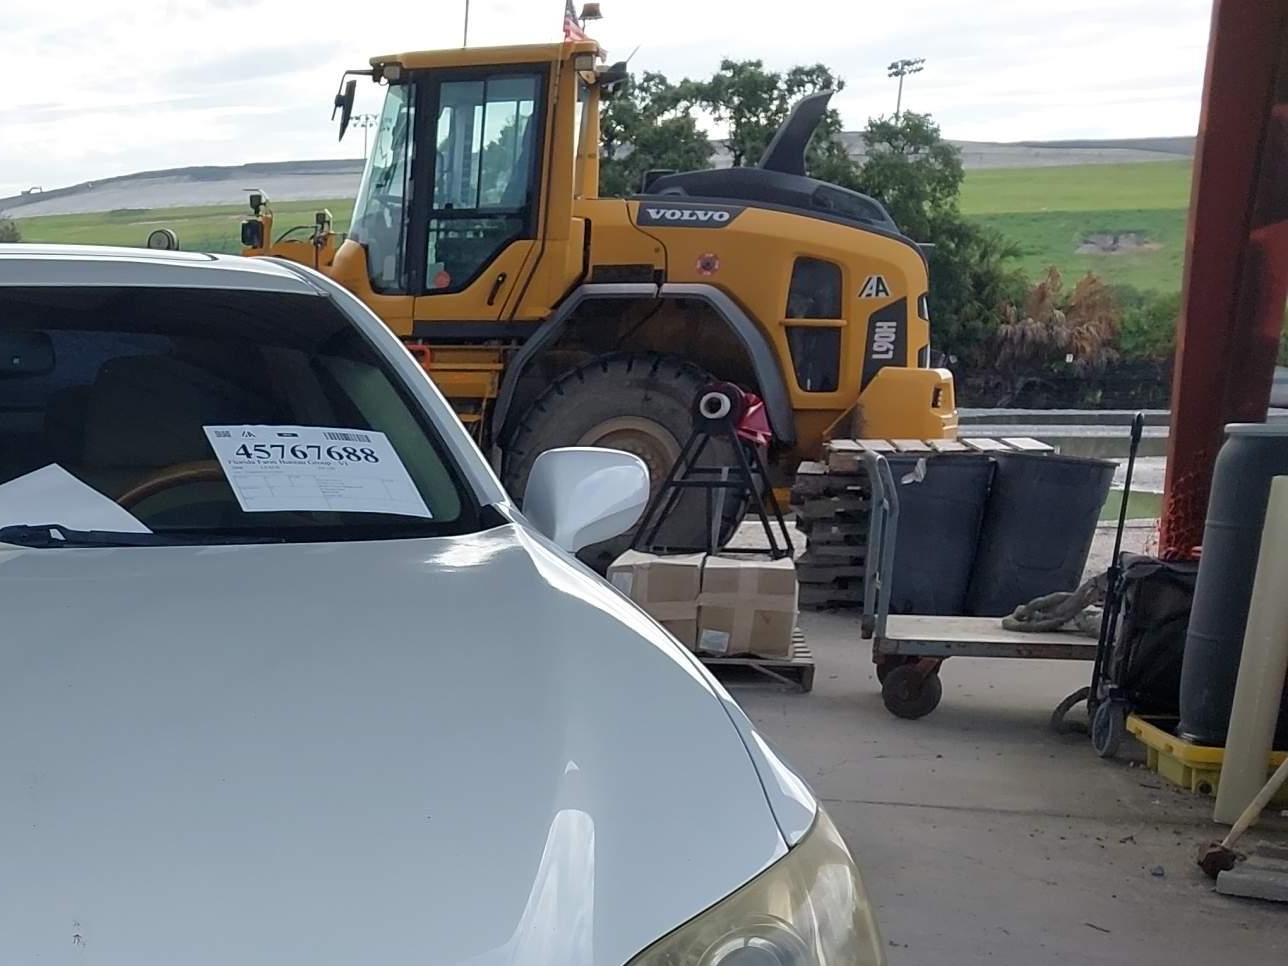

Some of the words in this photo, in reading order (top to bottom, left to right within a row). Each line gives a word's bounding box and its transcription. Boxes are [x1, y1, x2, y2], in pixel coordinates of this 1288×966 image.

[645, 208, 730, 222] VOLVO
[872, 321, 897, 360] L90H
[235, 443, 380, 464] 45767688
